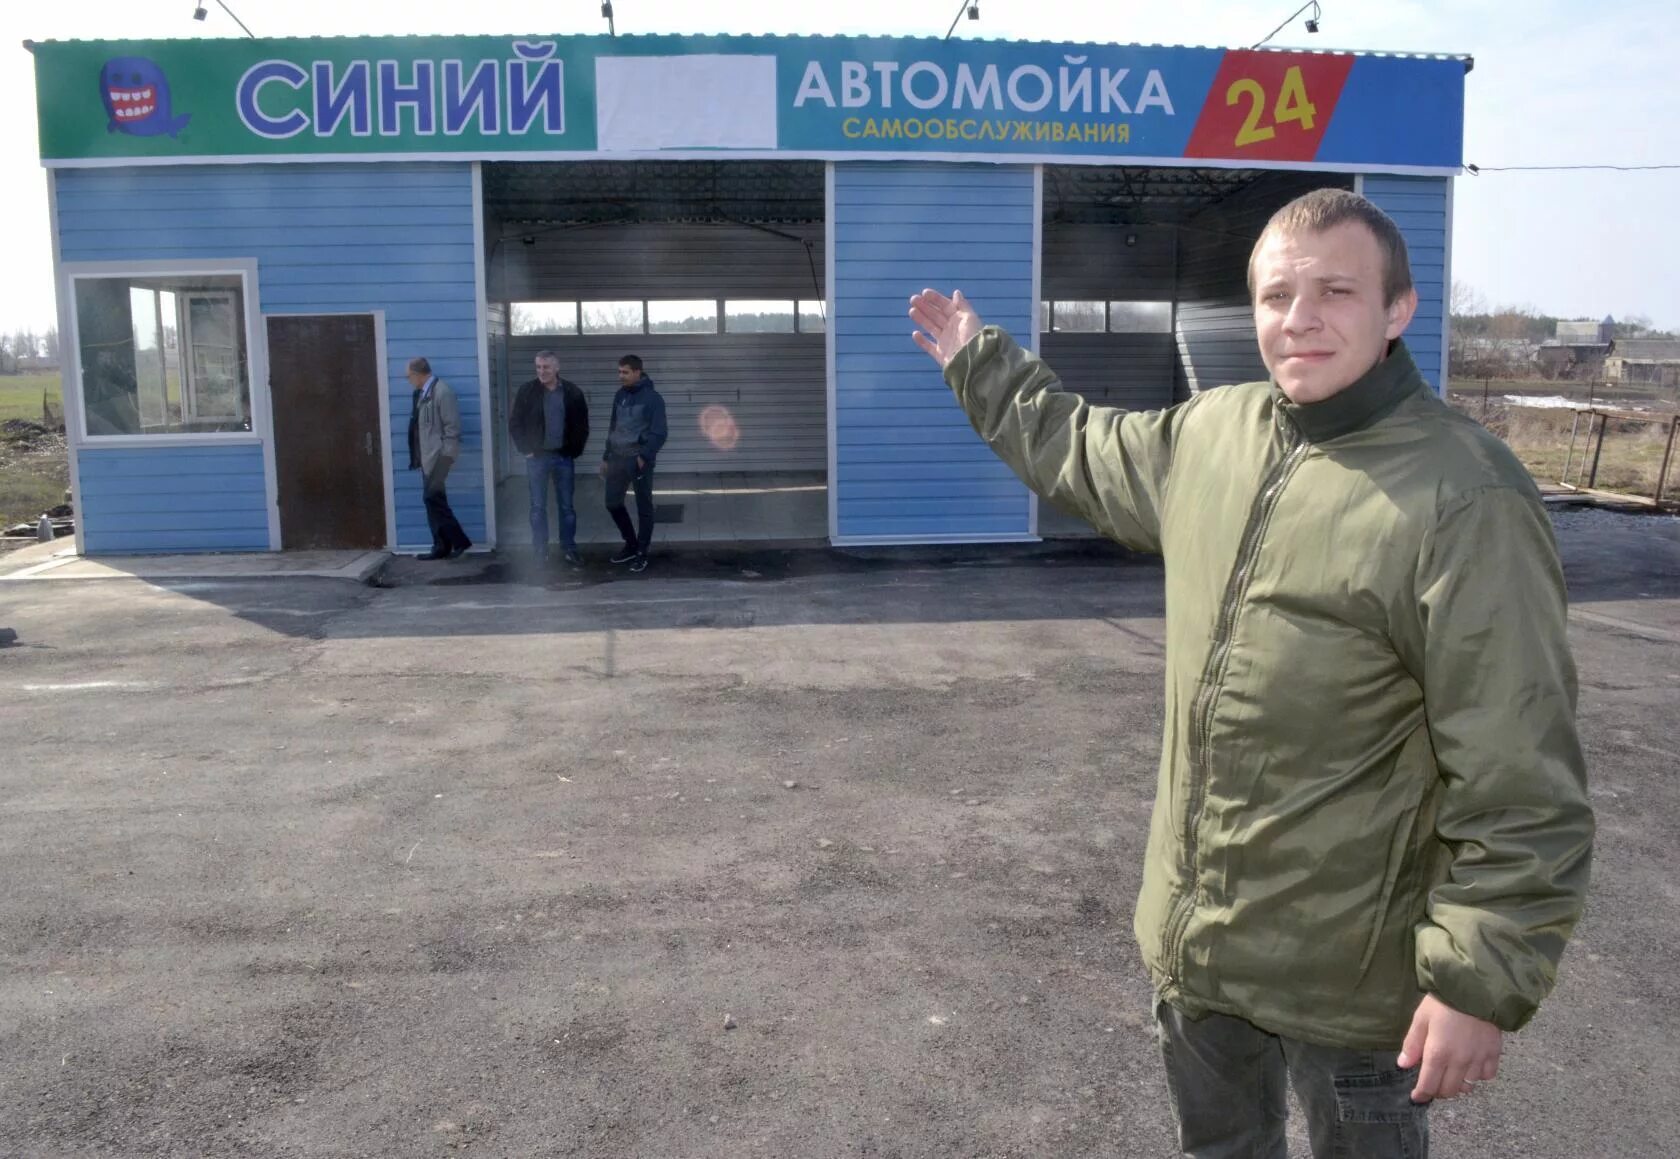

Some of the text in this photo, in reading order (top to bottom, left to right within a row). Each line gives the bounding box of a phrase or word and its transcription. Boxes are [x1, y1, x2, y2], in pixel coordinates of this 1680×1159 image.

[236, 41, 564, 139] СИНИЙ
[793, 55, 1175, 115] АВТОМОЙКА
[1227, 67, 1316, 146] 24
[843, 117, 1130, 143] САМООБСЛУЖИВАНИЯ
